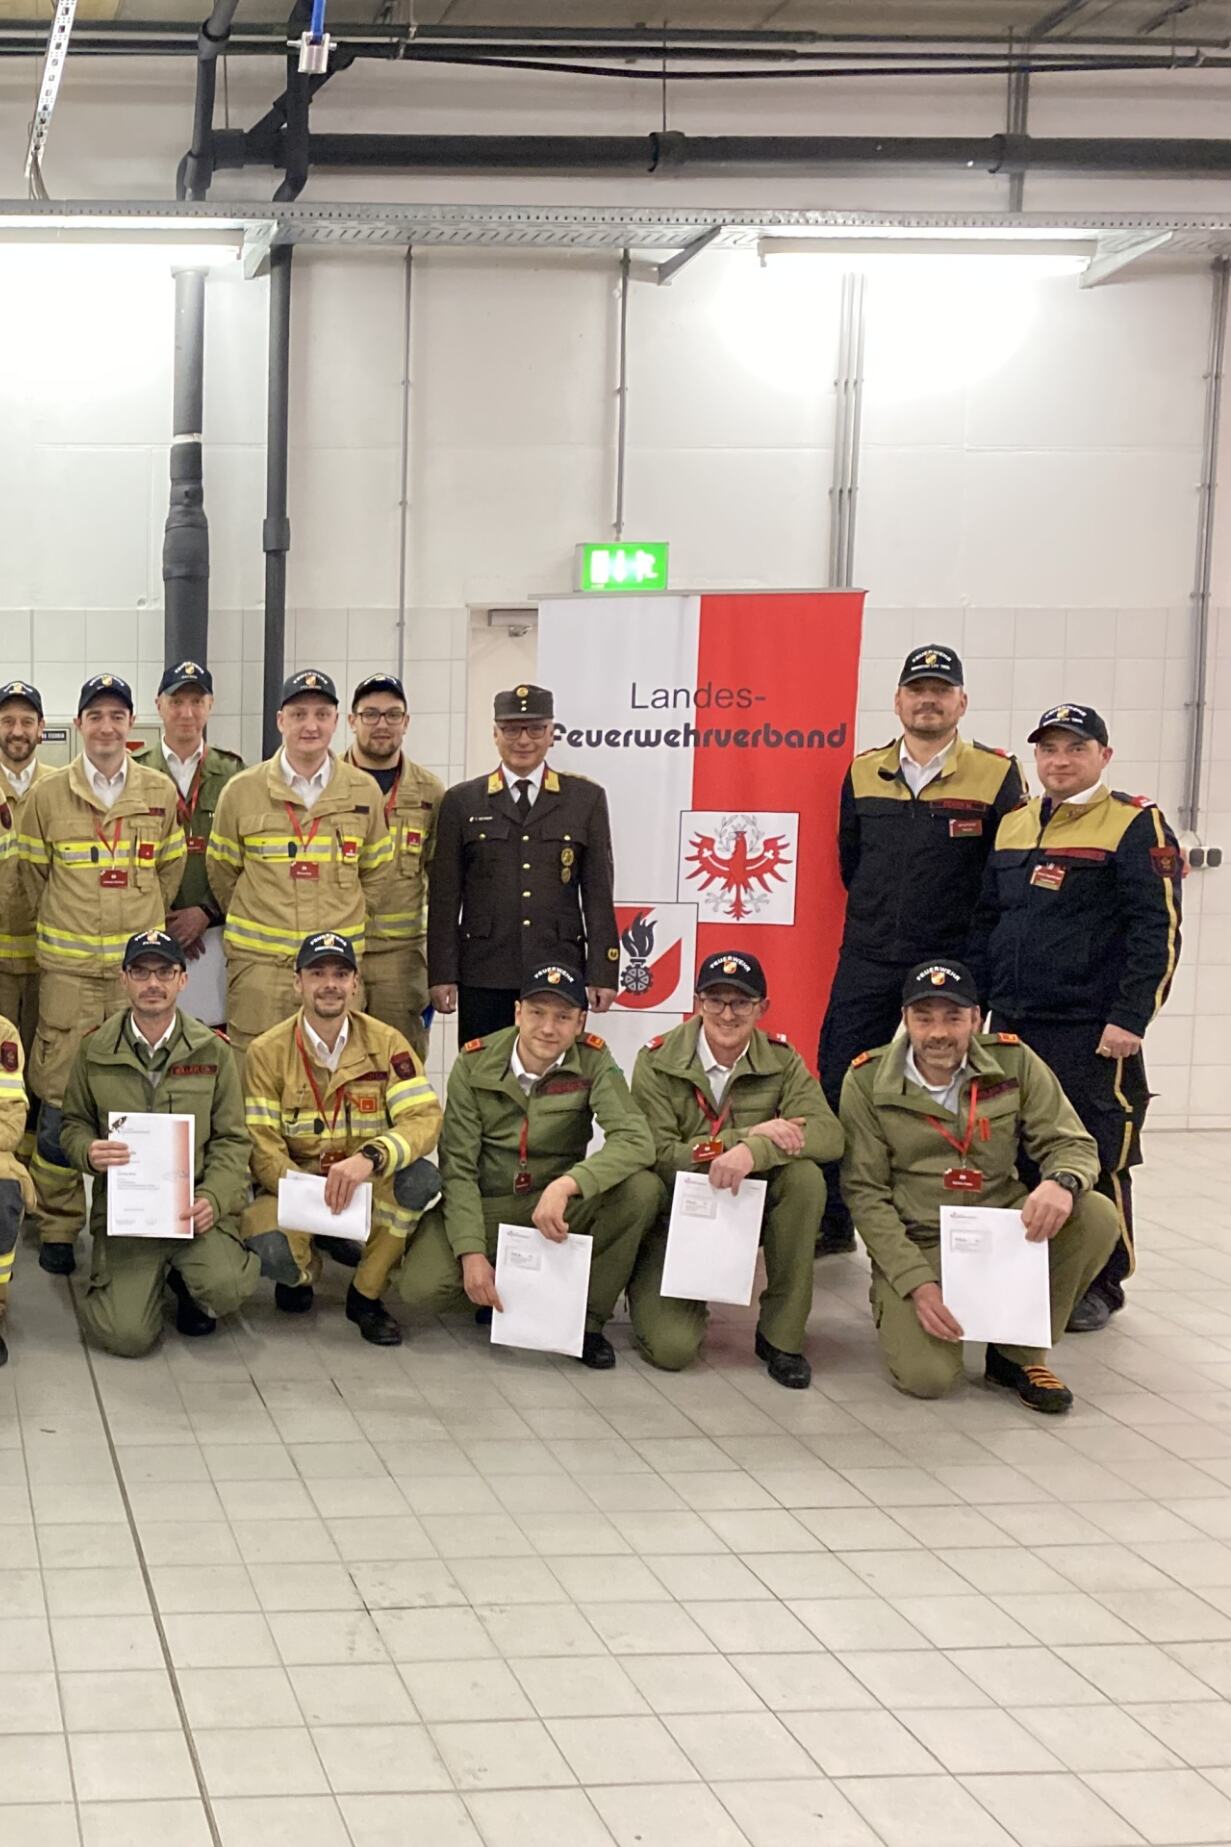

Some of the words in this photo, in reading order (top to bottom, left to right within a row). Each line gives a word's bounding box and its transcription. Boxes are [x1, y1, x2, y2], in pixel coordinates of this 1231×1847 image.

[630, 681, 767, 710] Landes-
[709, 955, 751, 973] FEUERWEHR
[534, 966, 575, 983] FEUERWEHR
[916, 966, 961, 982] FEUERWEHR
